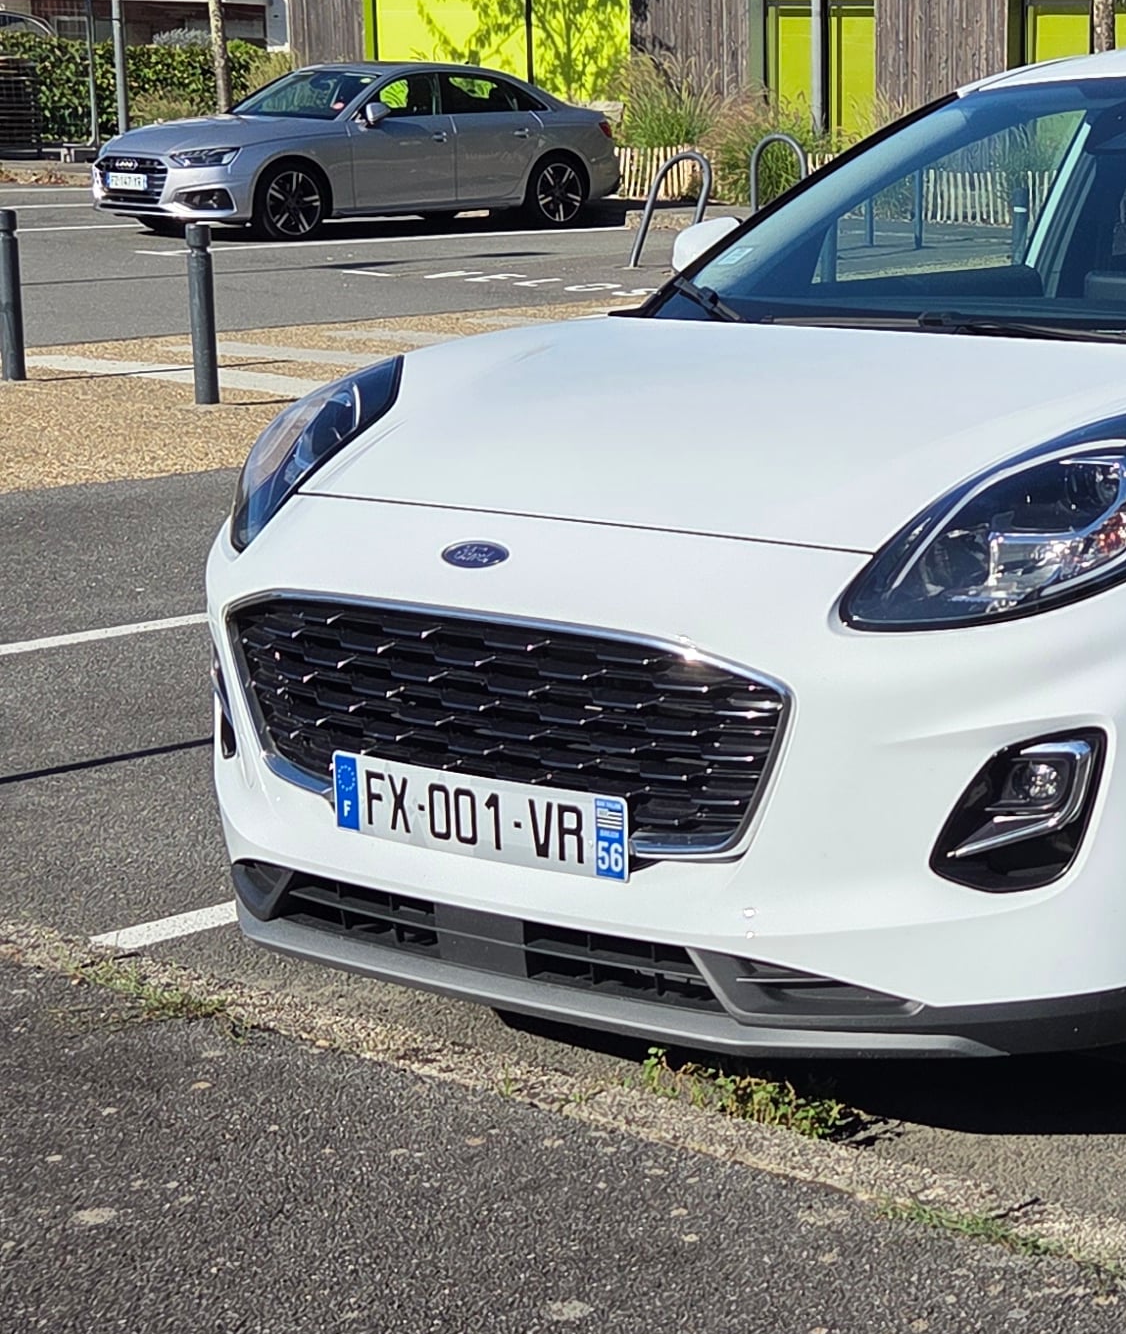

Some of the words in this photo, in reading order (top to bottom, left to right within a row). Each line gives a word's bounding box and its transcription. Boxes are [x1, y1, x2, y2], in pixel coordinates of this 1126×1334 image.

[424, 270, 661, 297] VELOS
[343, 799, 351, 817] F
[365, 769, 585, 865] FX-001-VR
[597, 840, 623, 873] 56
